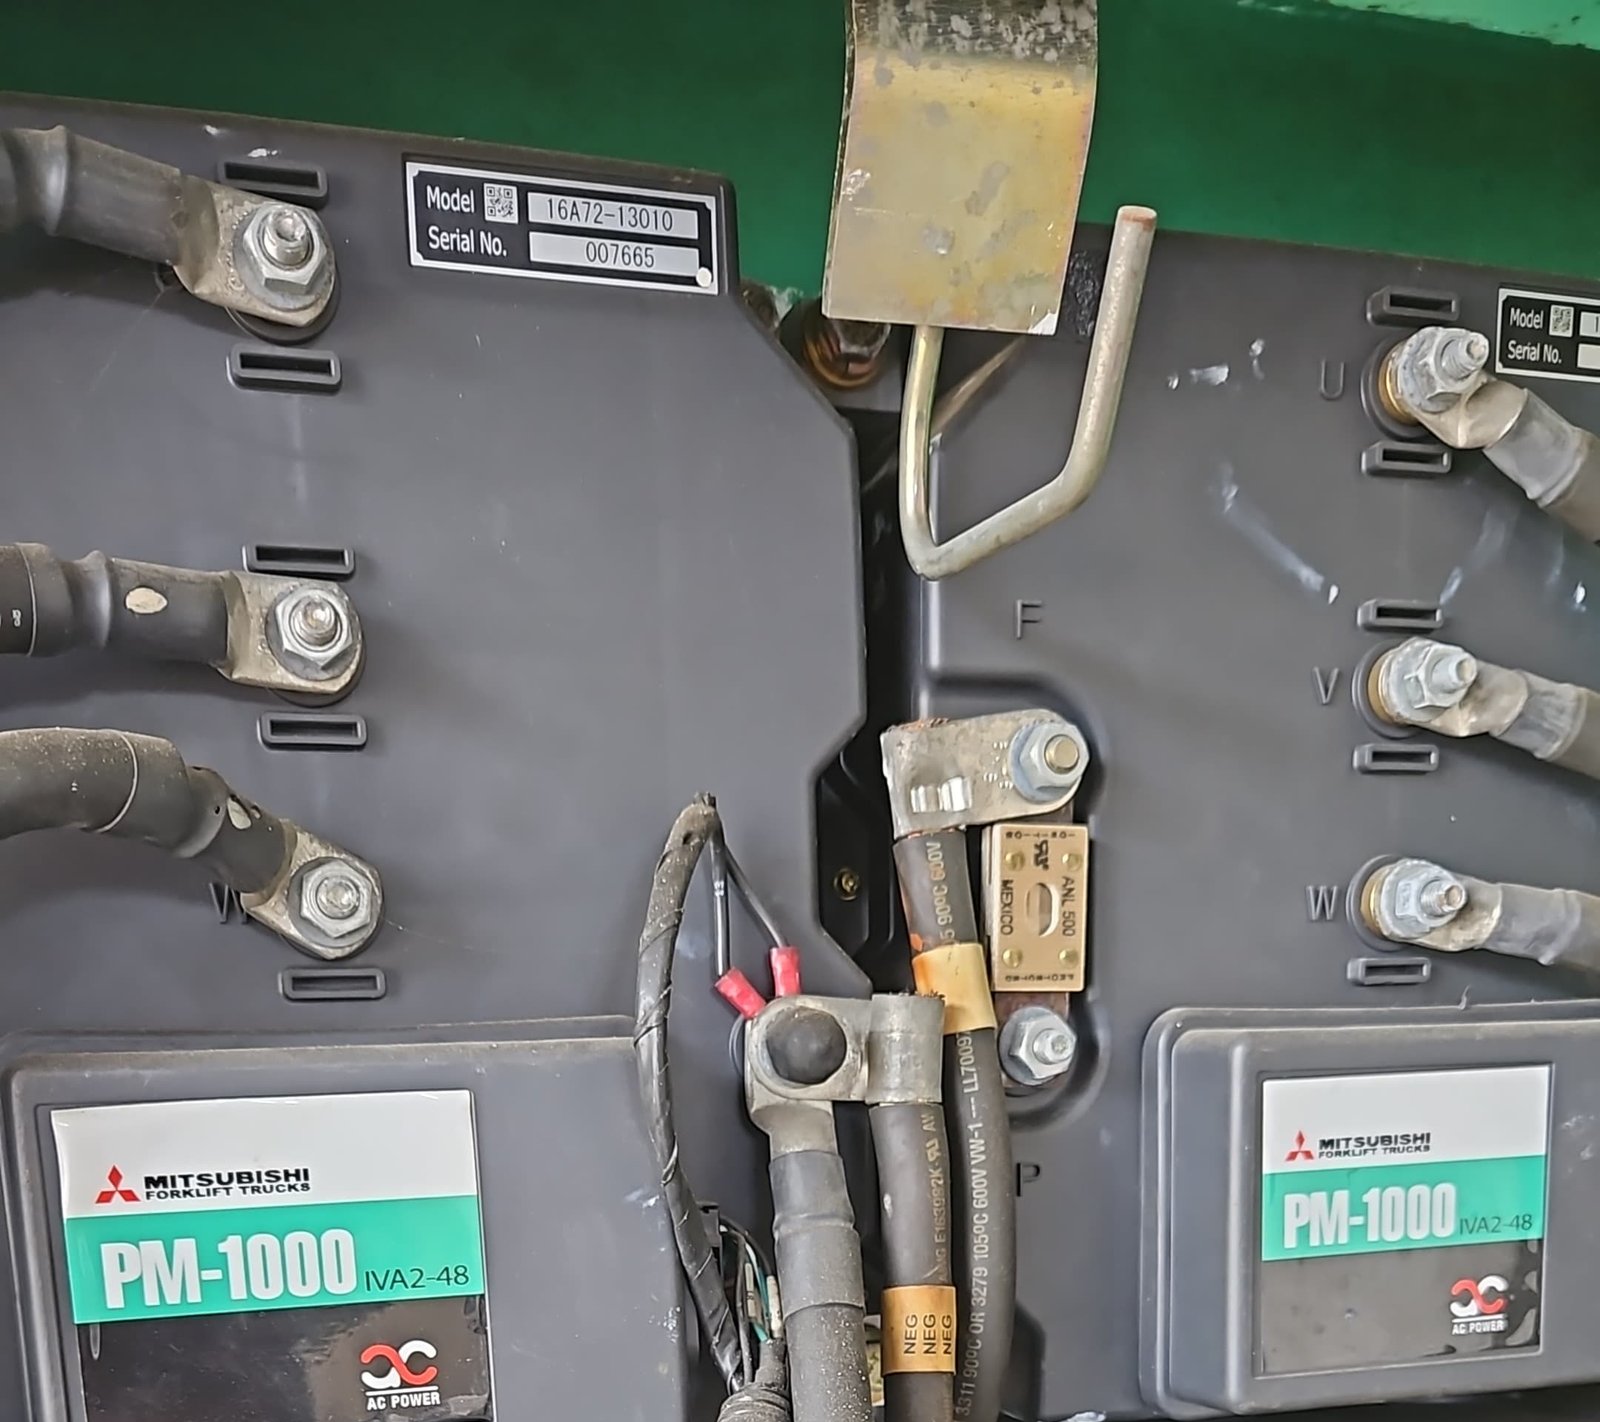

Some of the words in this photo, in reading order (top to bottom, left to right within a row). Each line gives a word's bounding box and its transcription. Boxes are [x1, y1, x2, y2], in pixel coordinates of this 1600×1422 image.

[426, 185, 474, 213] Model
[546, 197, 673, 232] 16A72-13010
[428, 225, 474, 253] Serial
[479, 231, 507, 257] No.
[586, 241, 654, 268] 007665
[1509, 307, 1544, 329] Model
[1507, 340, 1540, 361] Serial
[1543, 343, 1562, 364] No.
[1320, 359, 1345, 400] U
[1016, 599, 1042, 640] F
[1313, 666, 1339, 705] V
[1000, 879, 1014, 936] MEXICO
[1062, 876, 1076, 907] ANL
[1306, 885, 1338, 921] W
[1062, 911, 1076, 937] 500
[967, 1122, 987, 1166] VW-1
[1318, 1147, 1377, 1159] FORKLIFT
[1383, 1144, 1430, 1155] TRUCKS
[1319, 1132, 1431, 1150] MITSUBISHI
[144, 1168, 310, 1190] MITSUBISHI
[145, 1187, 233, 1201] FORKLIFT
[239, 1182, 311, 1197] TRUCKS
[971, 1168, 989, 1209] 600V
[1016, 1161, 1041, 1197] P
[1283, 1182, 1457, 1249] PM-1000
[1459, 1214, 1532, 1236] IVA2-48
[100, 1228, 357, 1309] PM-1000
[364, 1265, 470, 1292] IVA2-48
[971, 1266, 988, 1307] 3279
[903, 1314, 918, 1354] NEG
[922, 1314, 936, 1354] NEG
[941, 1314, 952, 1355] NEG
[968, 1311, 985, 1334] OR
[1452, 1323, 1466, 1335] AC
[1469, 1320, 1504, 1333] POWER
[367, 1394, 386, 1411] AC
[391, 1391, 441, 1408] POWER
[955, 1382, 976, 1416] 3311
